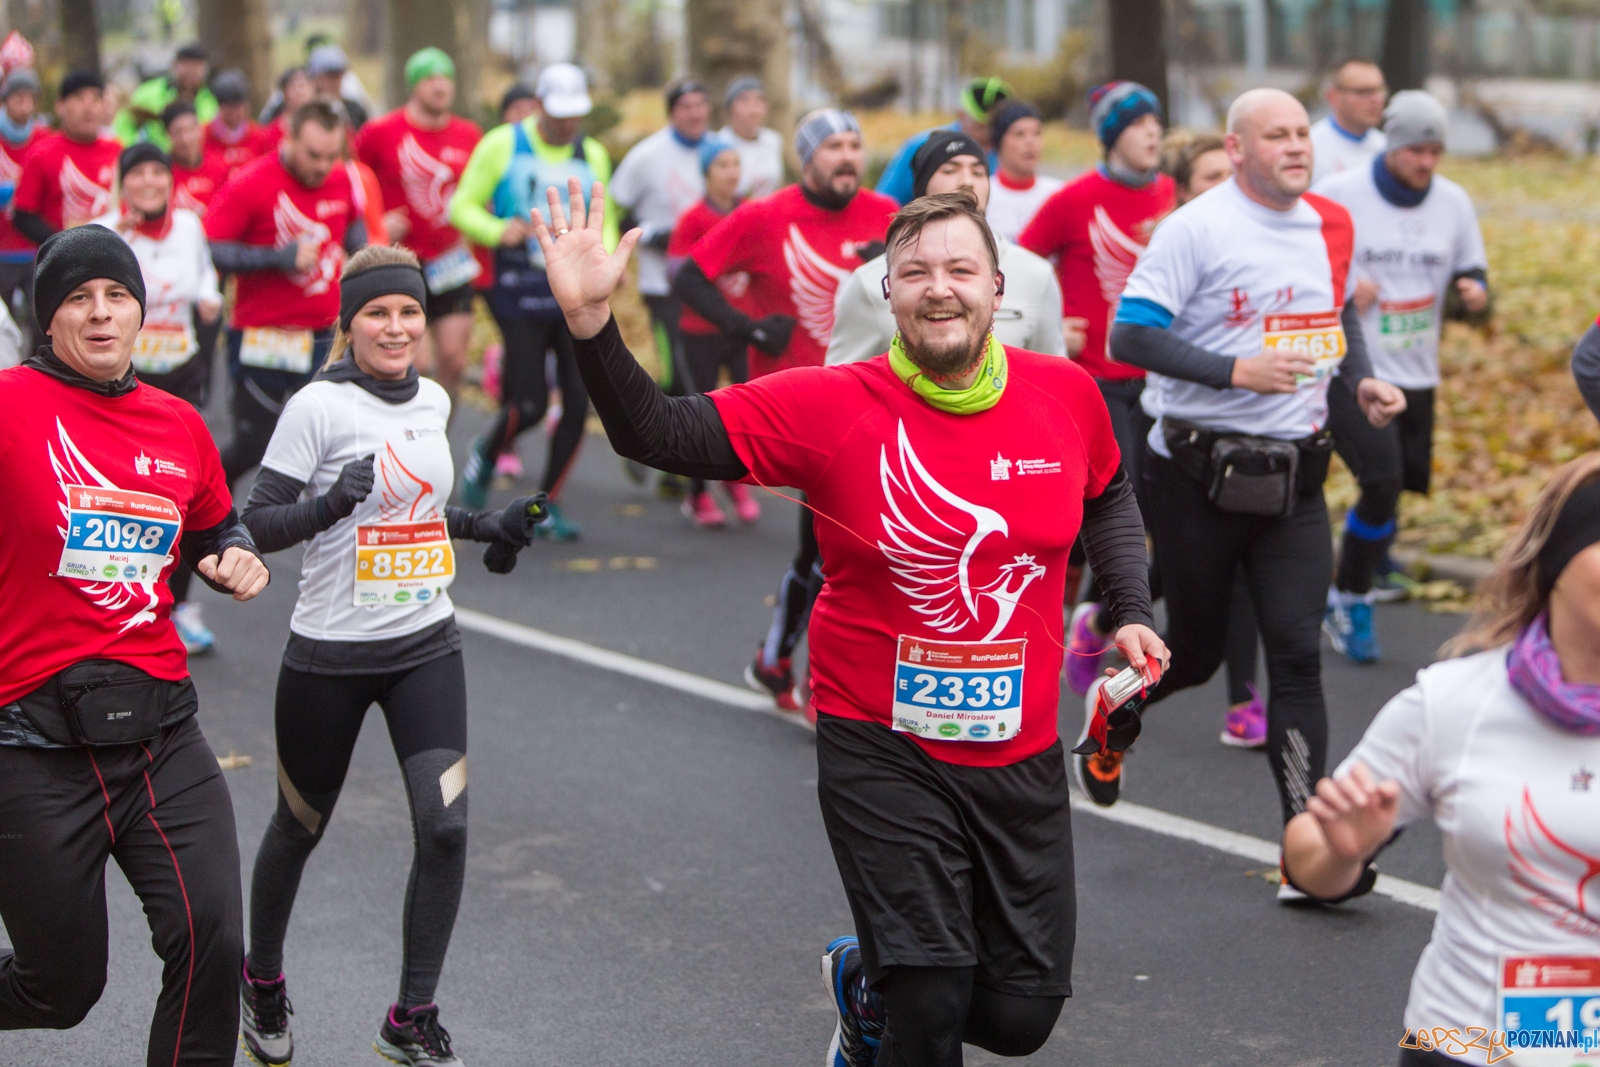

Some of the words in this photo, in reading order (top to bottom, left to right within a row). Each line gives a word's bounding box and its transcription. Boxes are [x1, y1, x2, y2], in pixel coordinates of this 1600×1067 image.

[1276, 333, 1338, 358] 6663
[1015, 459, 1026, 475] 1
[130, 502, 173, 515] RunPoland.org
[72, 526, 81, 537] E
[83, 518, 164, 550] 2098
[67, 562, 87, 570] GRUPA
[109, 555, 129, 563] Maciej
[360, 560, 369, 570] D
[372, 548, 445, 578] 8522
[971, 652, 1019, 662] RunPoland.org
[899, 678, 908, 690] E
[911, 673, 1013, 708] 2339
[898, 717, 919, 727] GRUPA
[926, 710, 954, 720] Daniel
[956, 711, 996, 721] Mirosław
[1505, 1012, 1521, 1030] E
